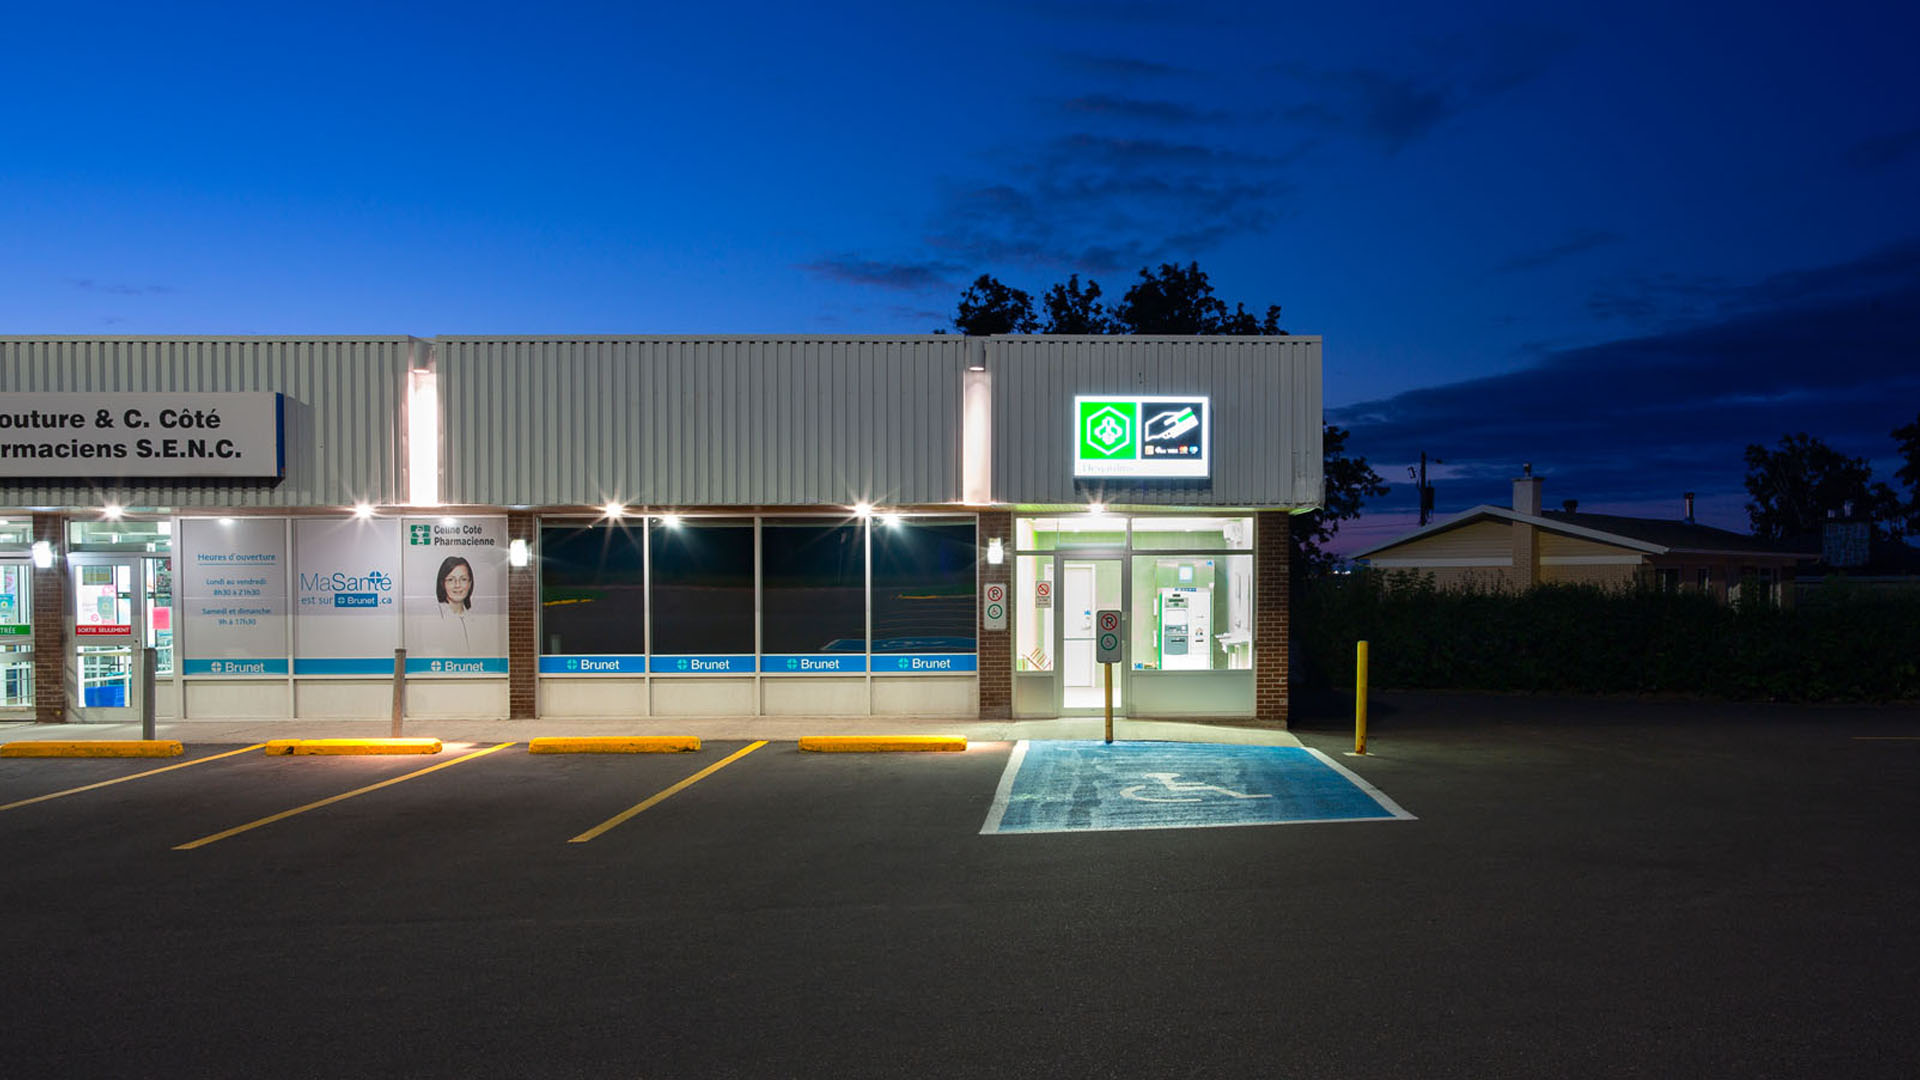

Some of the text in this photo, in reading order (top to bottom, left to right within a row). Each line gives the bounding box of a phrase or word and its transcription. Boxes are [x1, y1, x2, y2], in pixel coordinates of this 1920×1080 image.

[95, 409, 114, 428] &
[123, 409, 149, 428] C.
[159, 408, 221, 428] Côté
[1, 439, 242, 458] rmaciens S.E.N.C.
[434, 536, 495, 546] Pharmacienne
[198, 553, 227, 561] Heures
[301, 571, 391, 591] MaSanté
[302, 596, 316, 604] est
[347, 597, 375, 605] Brunet
[379, 597, 392, 605] .ca
[225, 662, 264, 673] Brunet
[445, 661, 484, 672] Brunet
[581, 659, 620, 670] Brunet
[691, 659, 730, 670] Brunet
[801, 659, 839, 669] Brunet
[912, 658, 951, 669] Brunet
